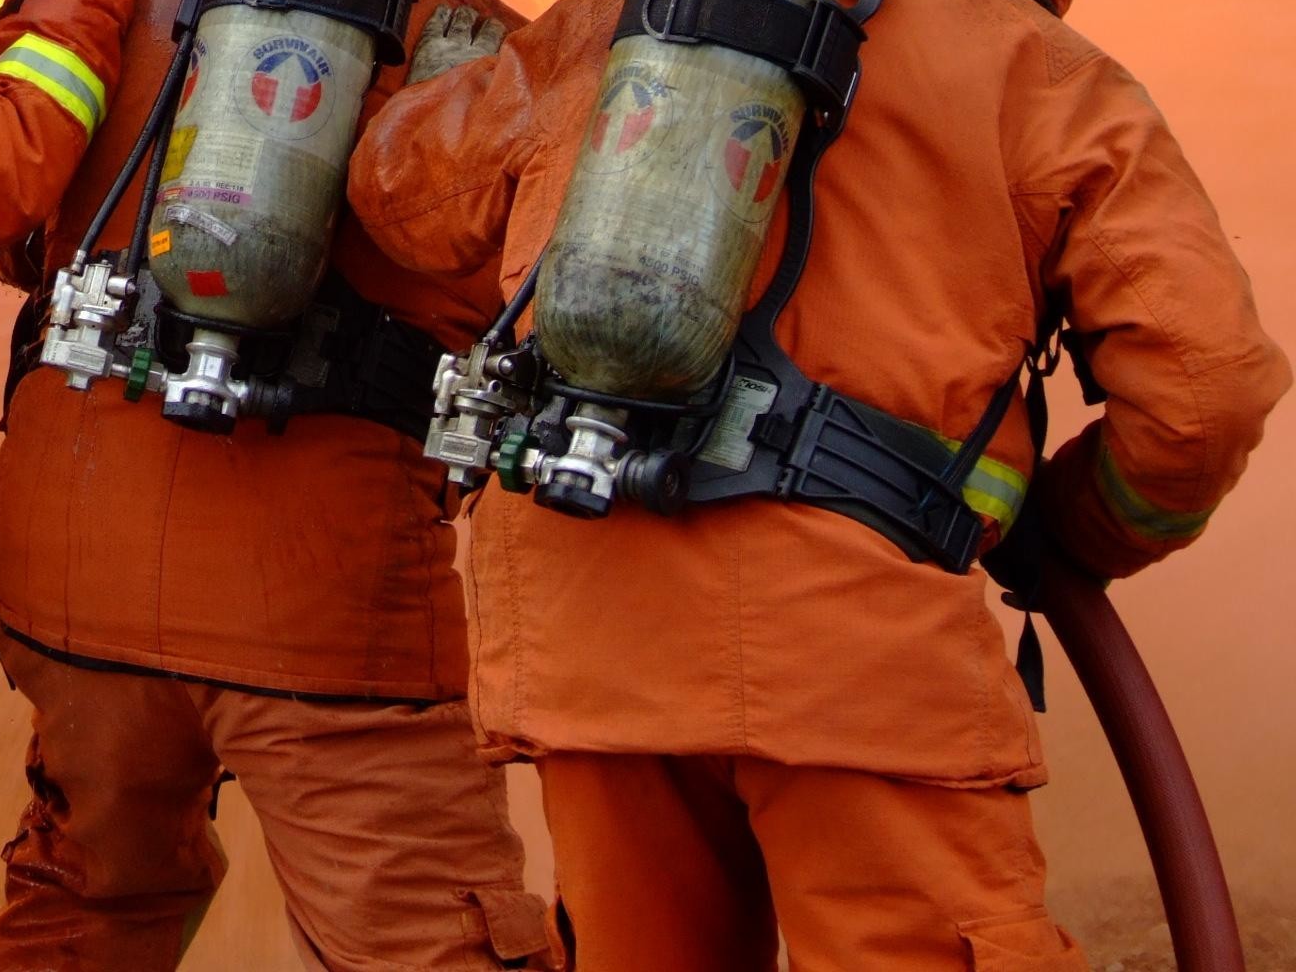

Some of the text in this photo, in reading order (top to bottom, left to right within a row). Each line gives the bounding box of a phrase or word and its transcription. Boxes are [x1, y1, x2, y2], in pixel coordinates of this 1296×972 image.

[253, 37, 332, 76] SURVIVAIR
[213, 191, 241, 204] PSIG
[671, 265, 700, 287] PSIG
